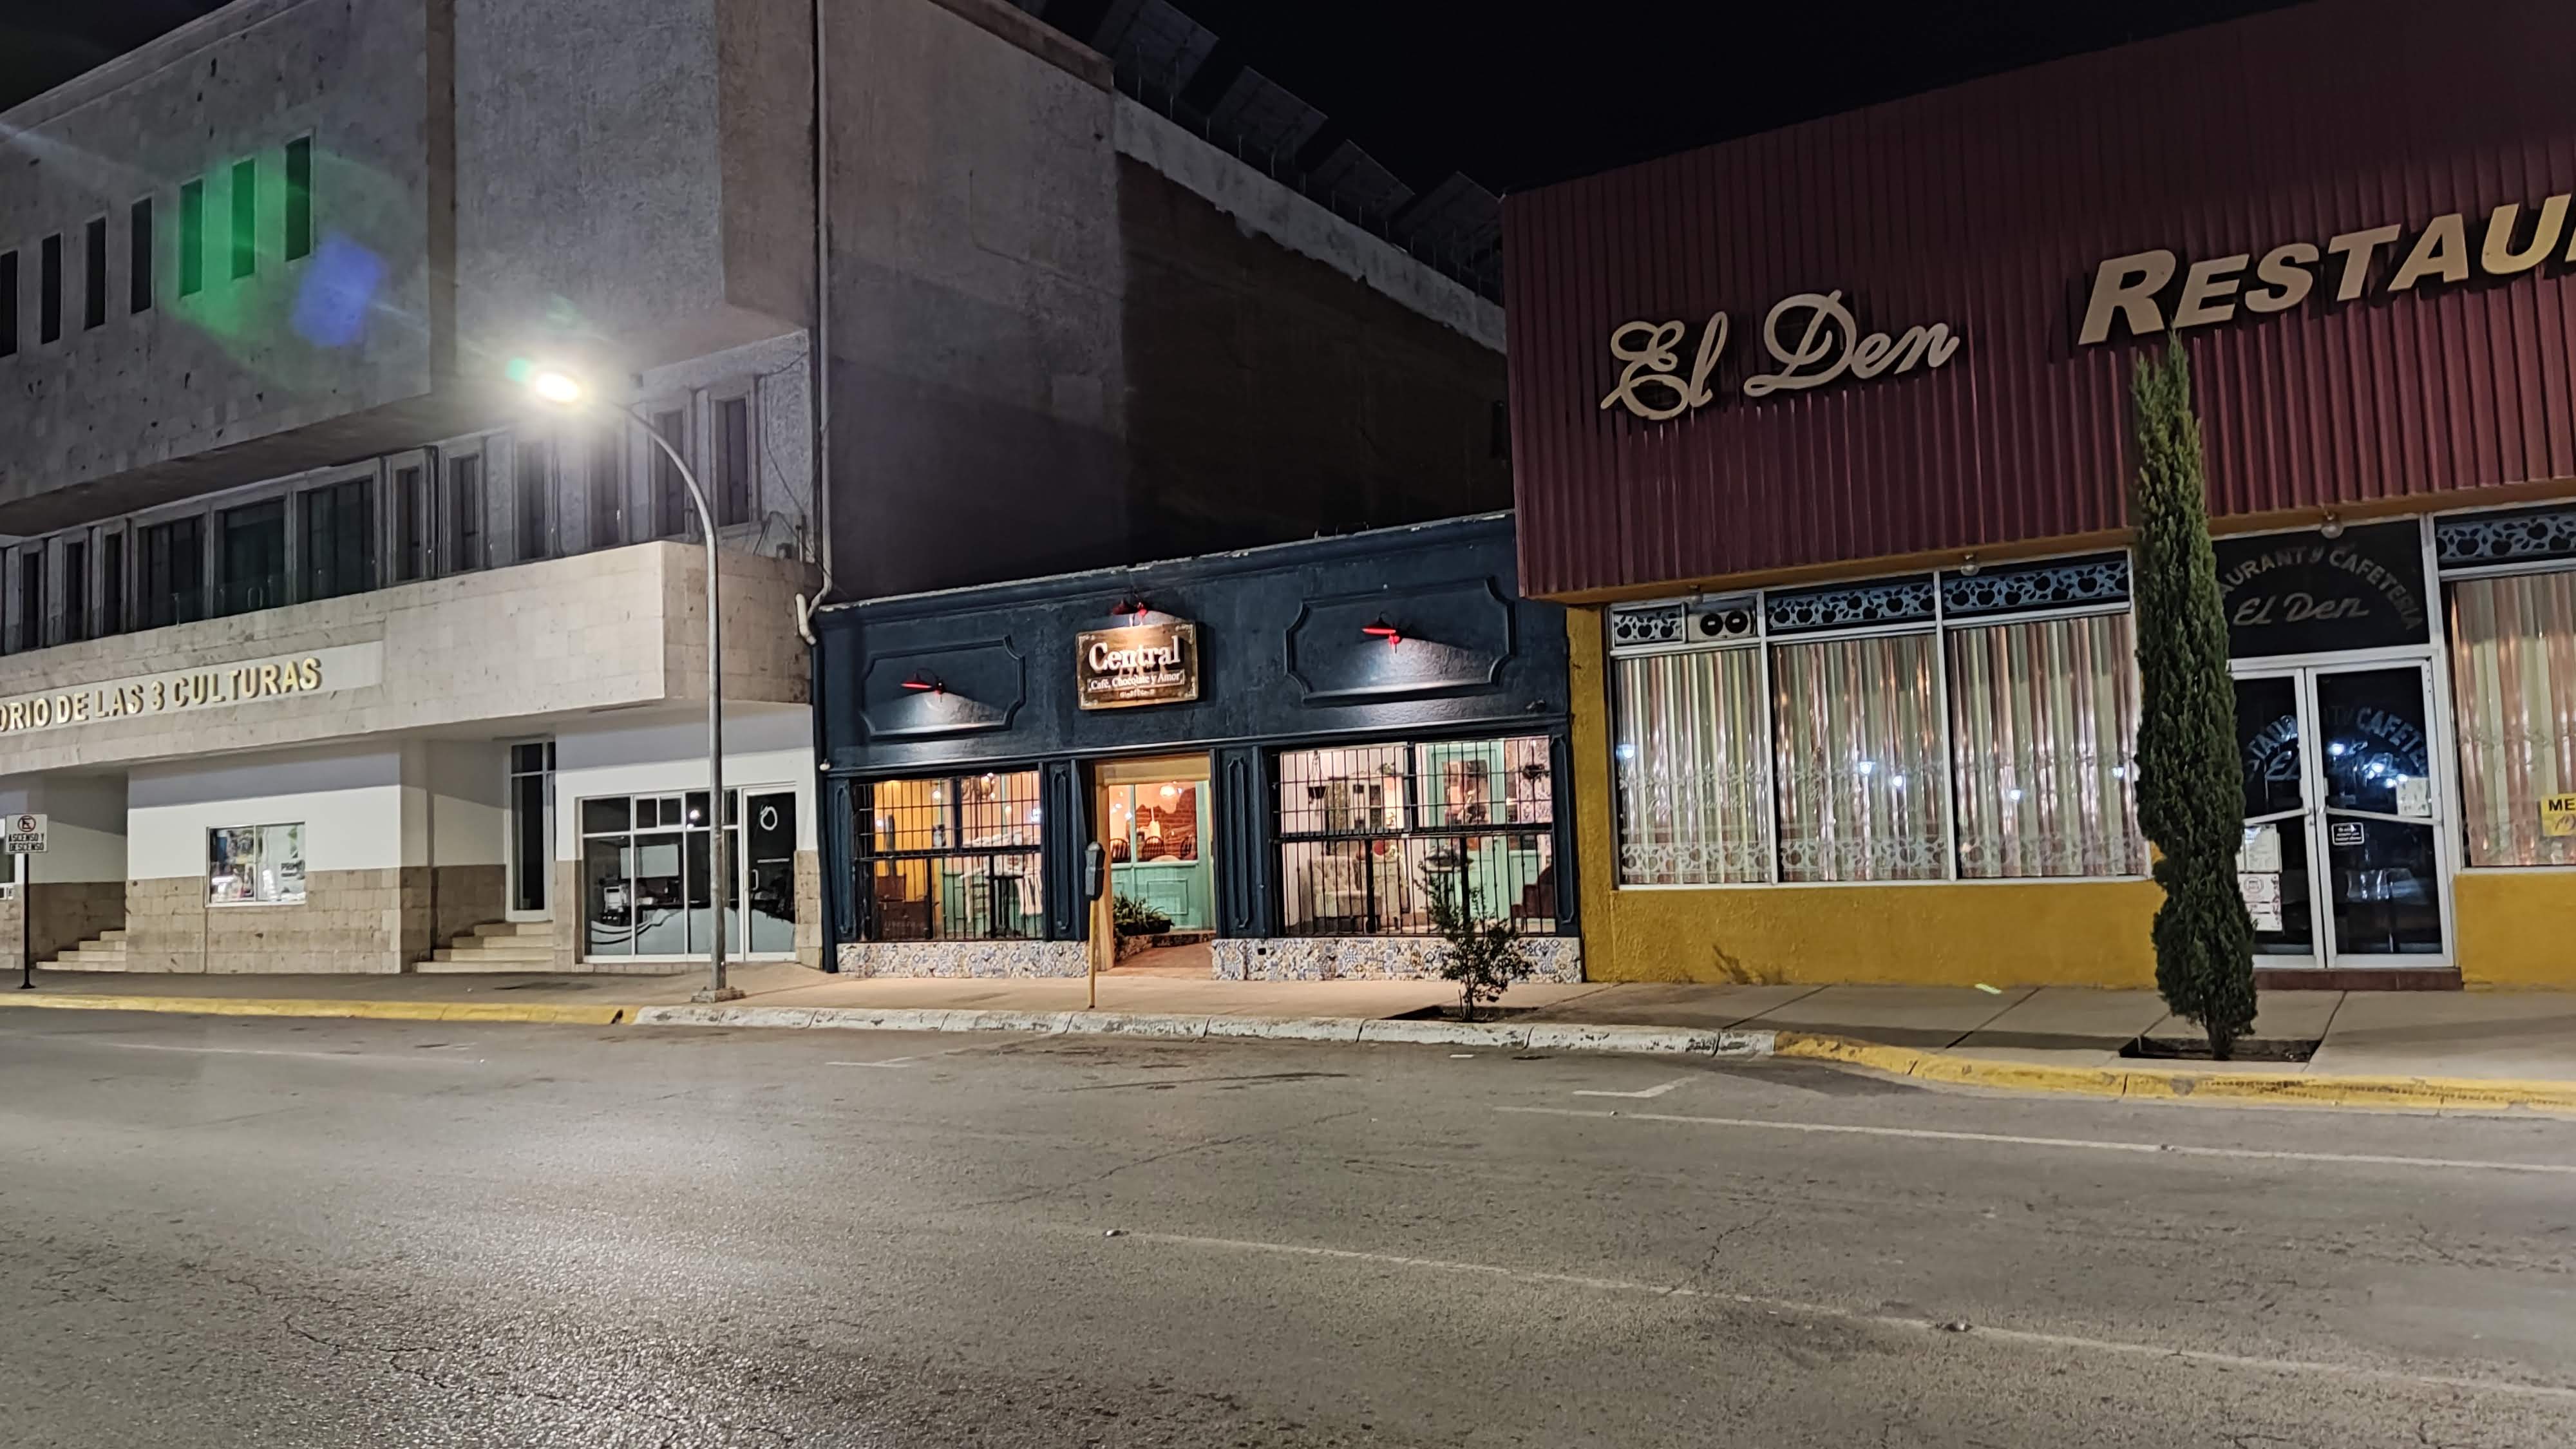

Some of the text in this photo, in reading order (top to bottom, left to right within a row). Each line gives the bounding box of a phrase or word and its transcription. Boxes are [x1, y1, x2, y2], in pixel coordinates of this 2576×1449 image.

[2079, 194, 2576, 345] RESTAU
[1600, 290, 1960, 420] El Den
[1089, 635, 1181, 672] Central
[57, 691, 89, 724] DE
[96, 685, 144, 718] LAS
[151, 680, 165, 711] 3
[173, 658, 322, 706] CULTURAS
[1151, 674, 1157, 685] y
[1158, 672, 1180, 683] Amor
[8, 833, 45, 842] ASCENSO Y
[9, 842, 44, 851] DESCENSO
